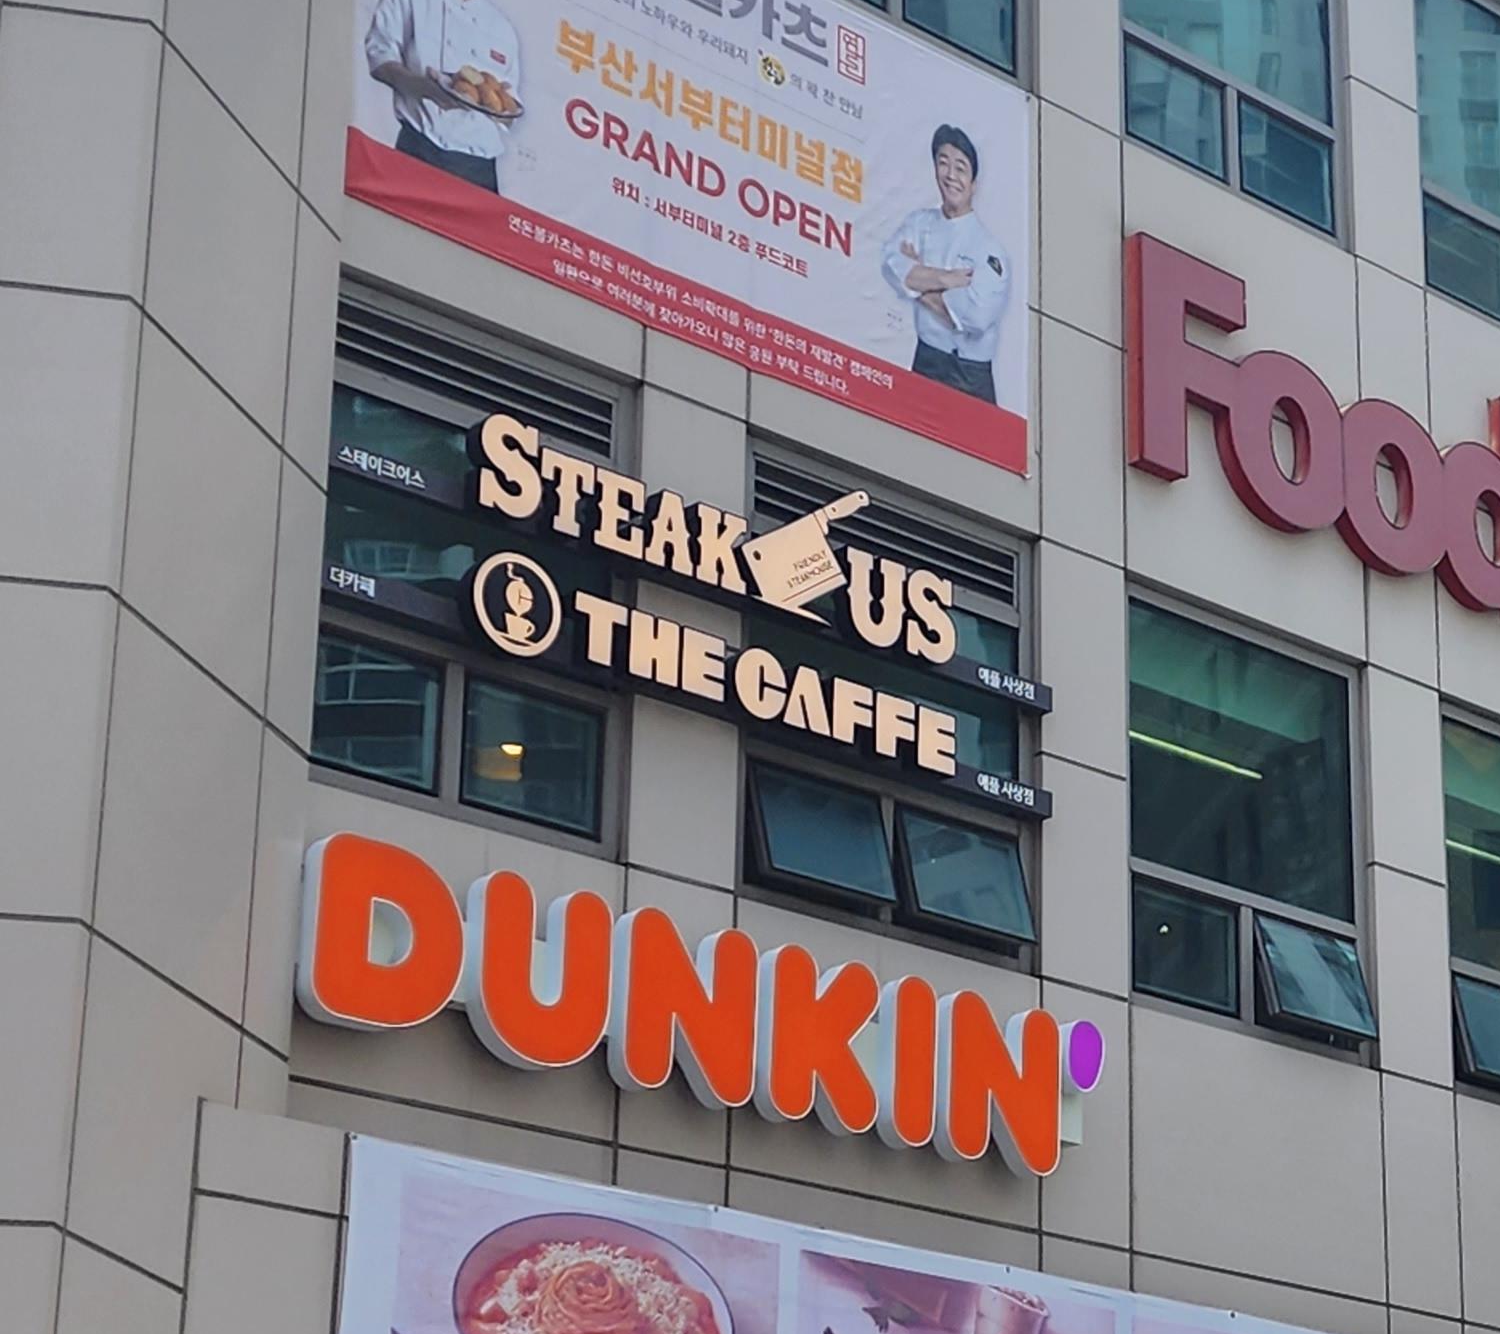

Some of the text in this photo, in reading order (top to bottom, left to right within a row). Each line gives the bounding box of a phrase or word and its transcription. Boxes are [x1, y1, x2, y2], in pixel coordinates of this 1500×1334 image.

[556, 20, 862, 203] 부산서부터미널점
[565, 98, 853, 257] GRAND OPEN
[612, 176, 640, 204] 위치
[653, 196, 723, 242] 서부터미널
[727, 228, 751, 253] 2층
[755, 240, 808, 278] 푸드코트
[337, 446, 426, 489] 스테이크어스
[329, 567, 375, 597] 더카페
[474, 413, 956, 665] STEAK US
[575, 590, 956, 776] THE CAFFE
[978, 667, 1035, 700] 애플 사상점
[977, 773, 1035, 806] 애플 사상점
[298, 830, 1104, 1176] DUNKIN'
